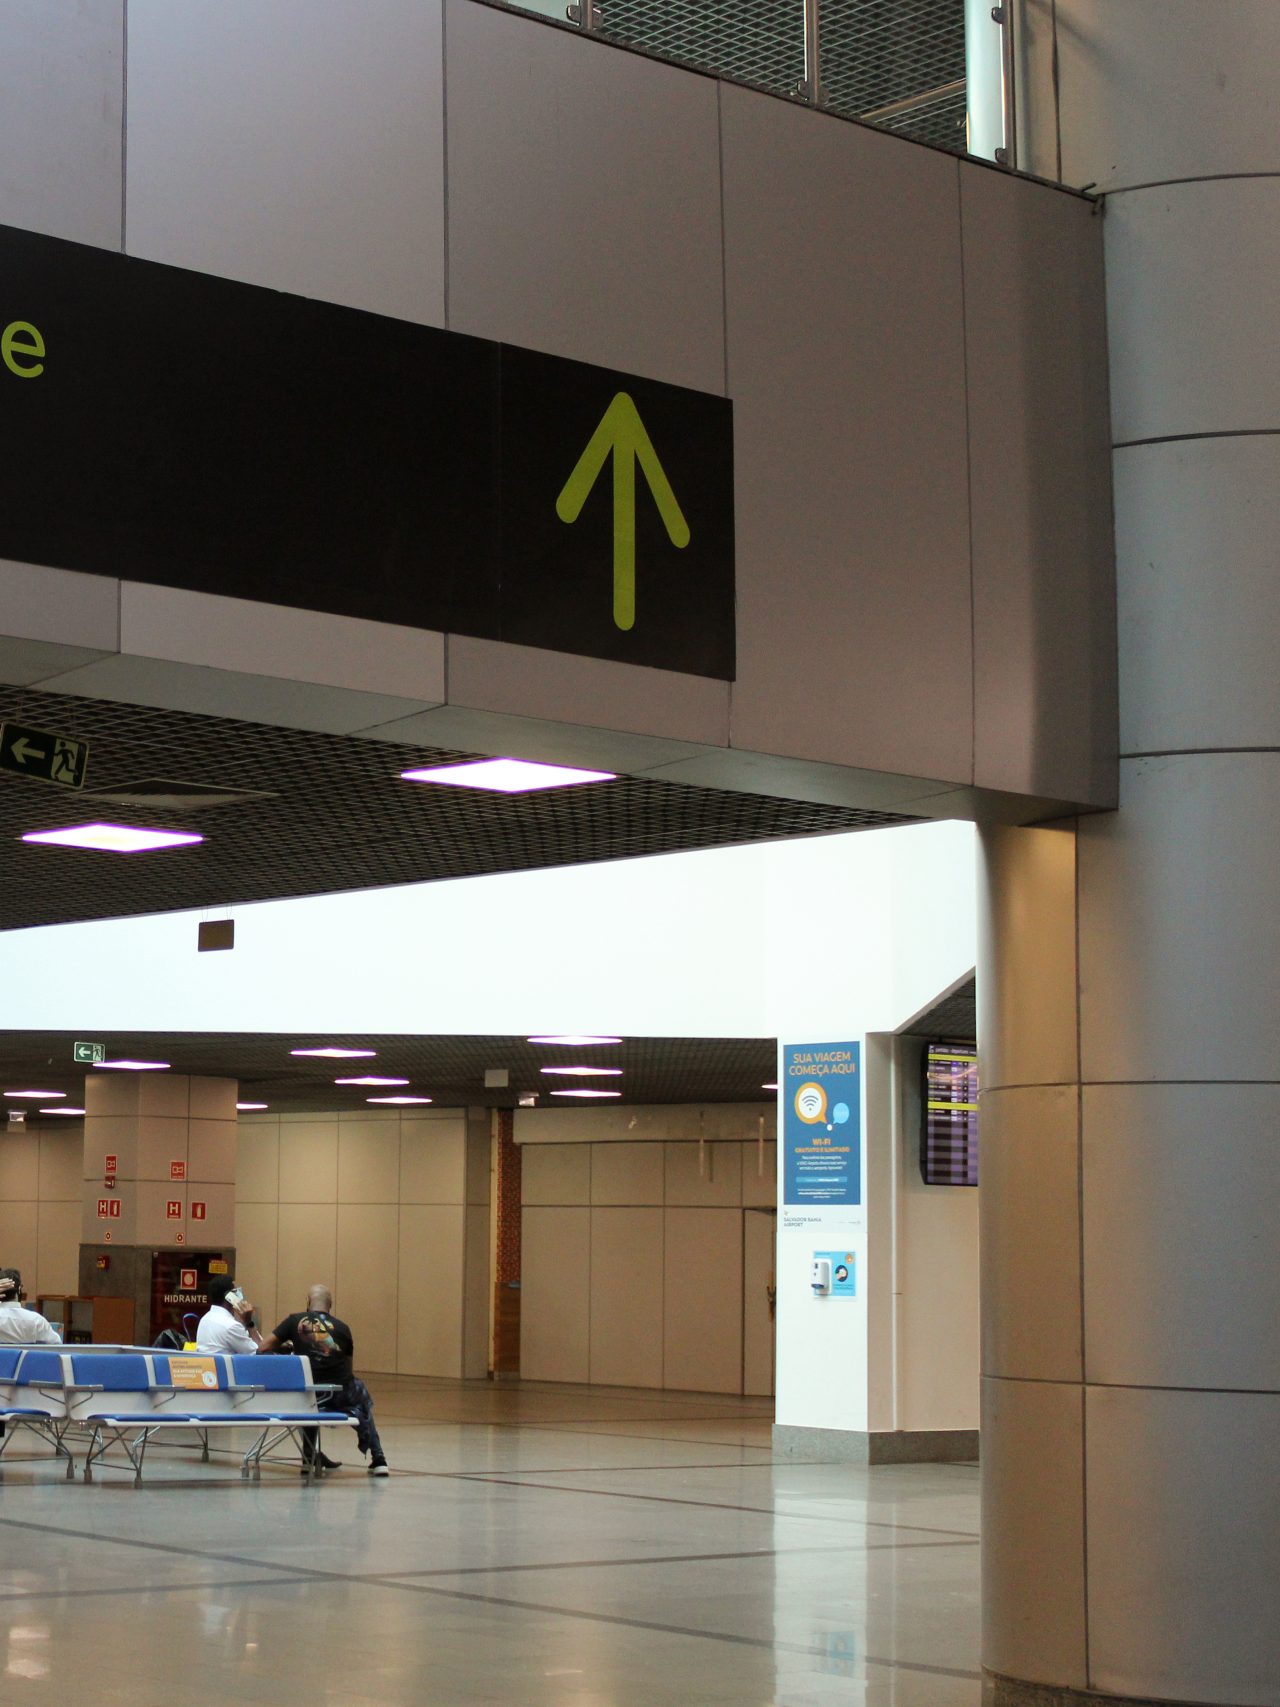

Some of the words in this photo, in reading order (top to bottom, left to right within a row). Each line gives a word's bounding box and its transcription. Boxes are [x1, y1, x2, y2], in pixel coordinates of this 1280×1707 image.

[793, 1053, 812, 1063] SUA
[814, 1052, 851, 1062] VIAGEM
[789, 1064, 830, 1077] COMEÇA
[831, 1063, 856, 1075] AQUI
[164, 1294, 208, 1304] HIDRANTE
